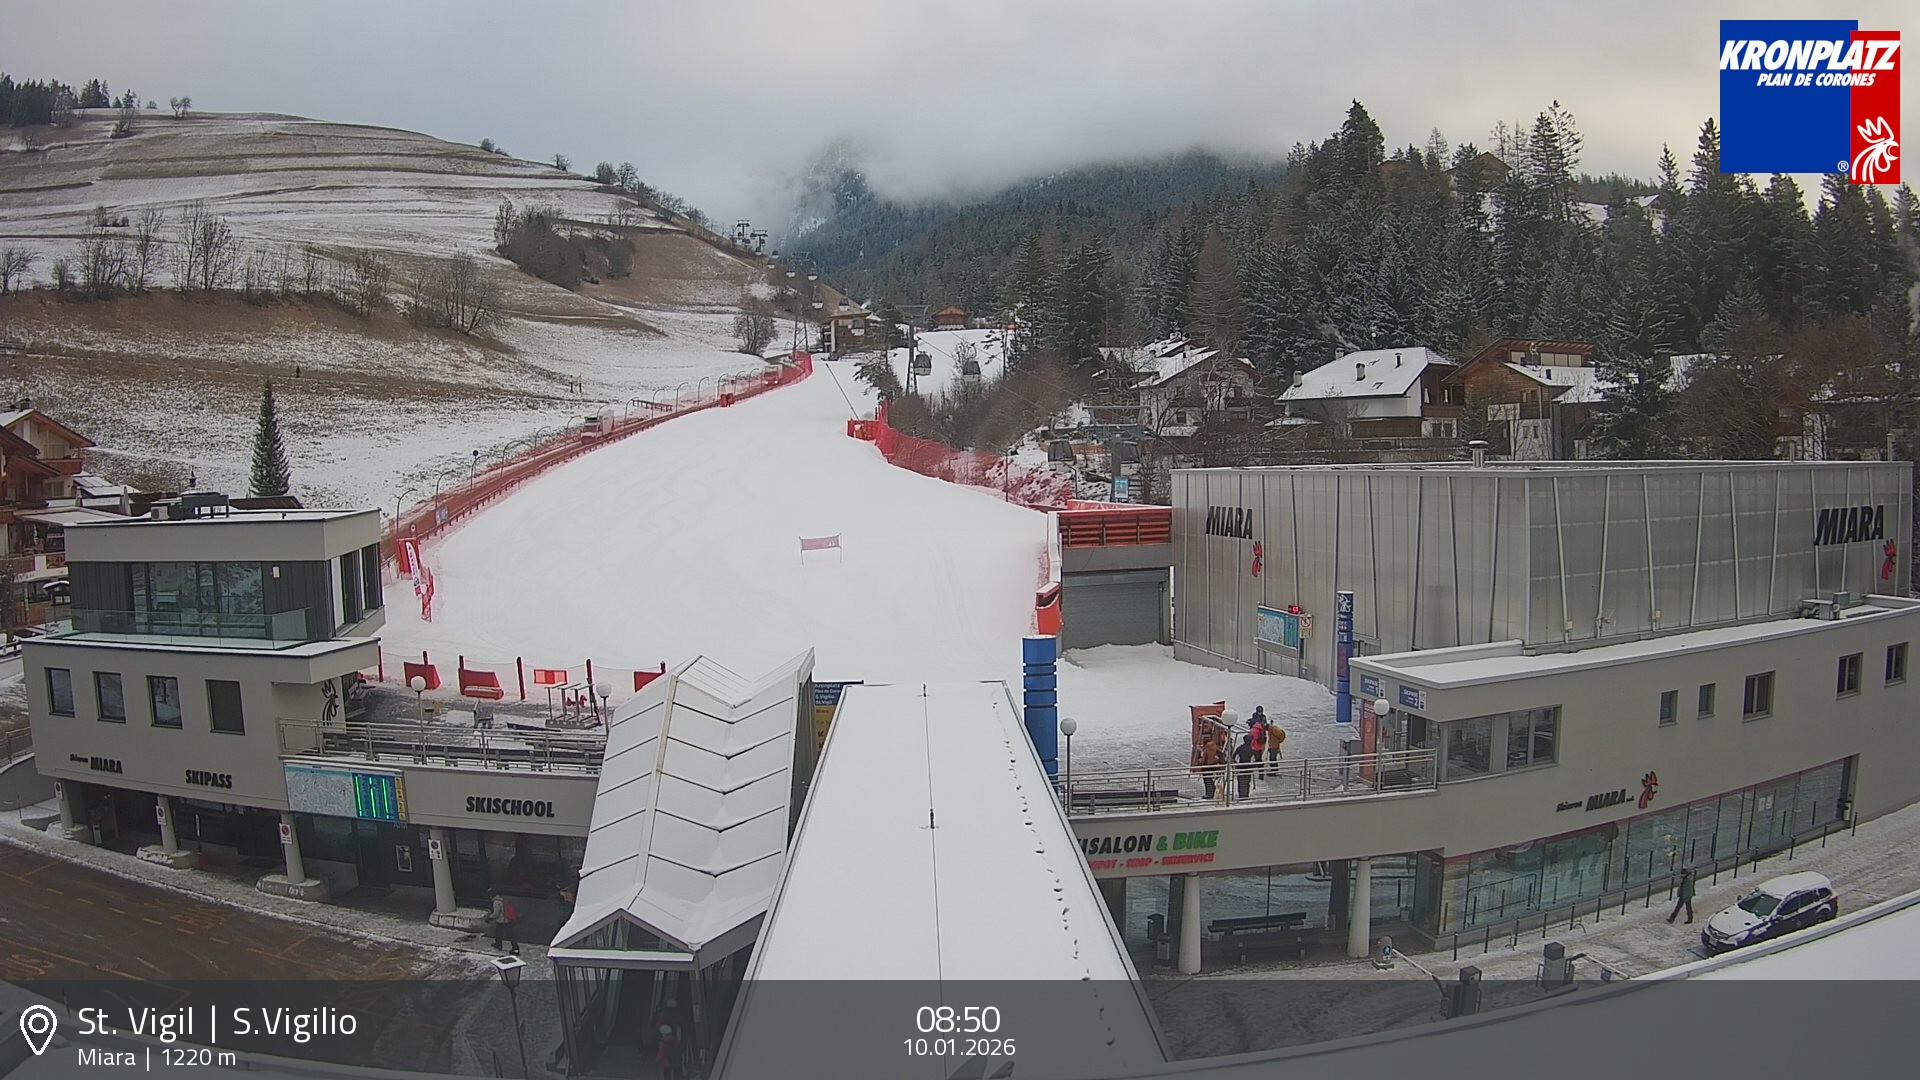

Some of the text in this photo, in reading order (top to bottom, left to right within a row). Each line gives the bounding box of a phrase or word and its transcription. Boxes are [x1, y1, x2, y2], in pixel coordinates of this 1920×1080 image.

[1206, 505, 1253, 540] MIARA
[1814, 504, 1884, 546] MIARA
[90, 756, 123, 775] MIARA
[185, 769, 233, 789] SKIPASS
[466, 796, 555, 818] SKISCHOOL
[1585, 789, 1626, 812] MIARA
[1156, 836, 1168, 851] &
[1173, 830, 1219, 849] BIKE
